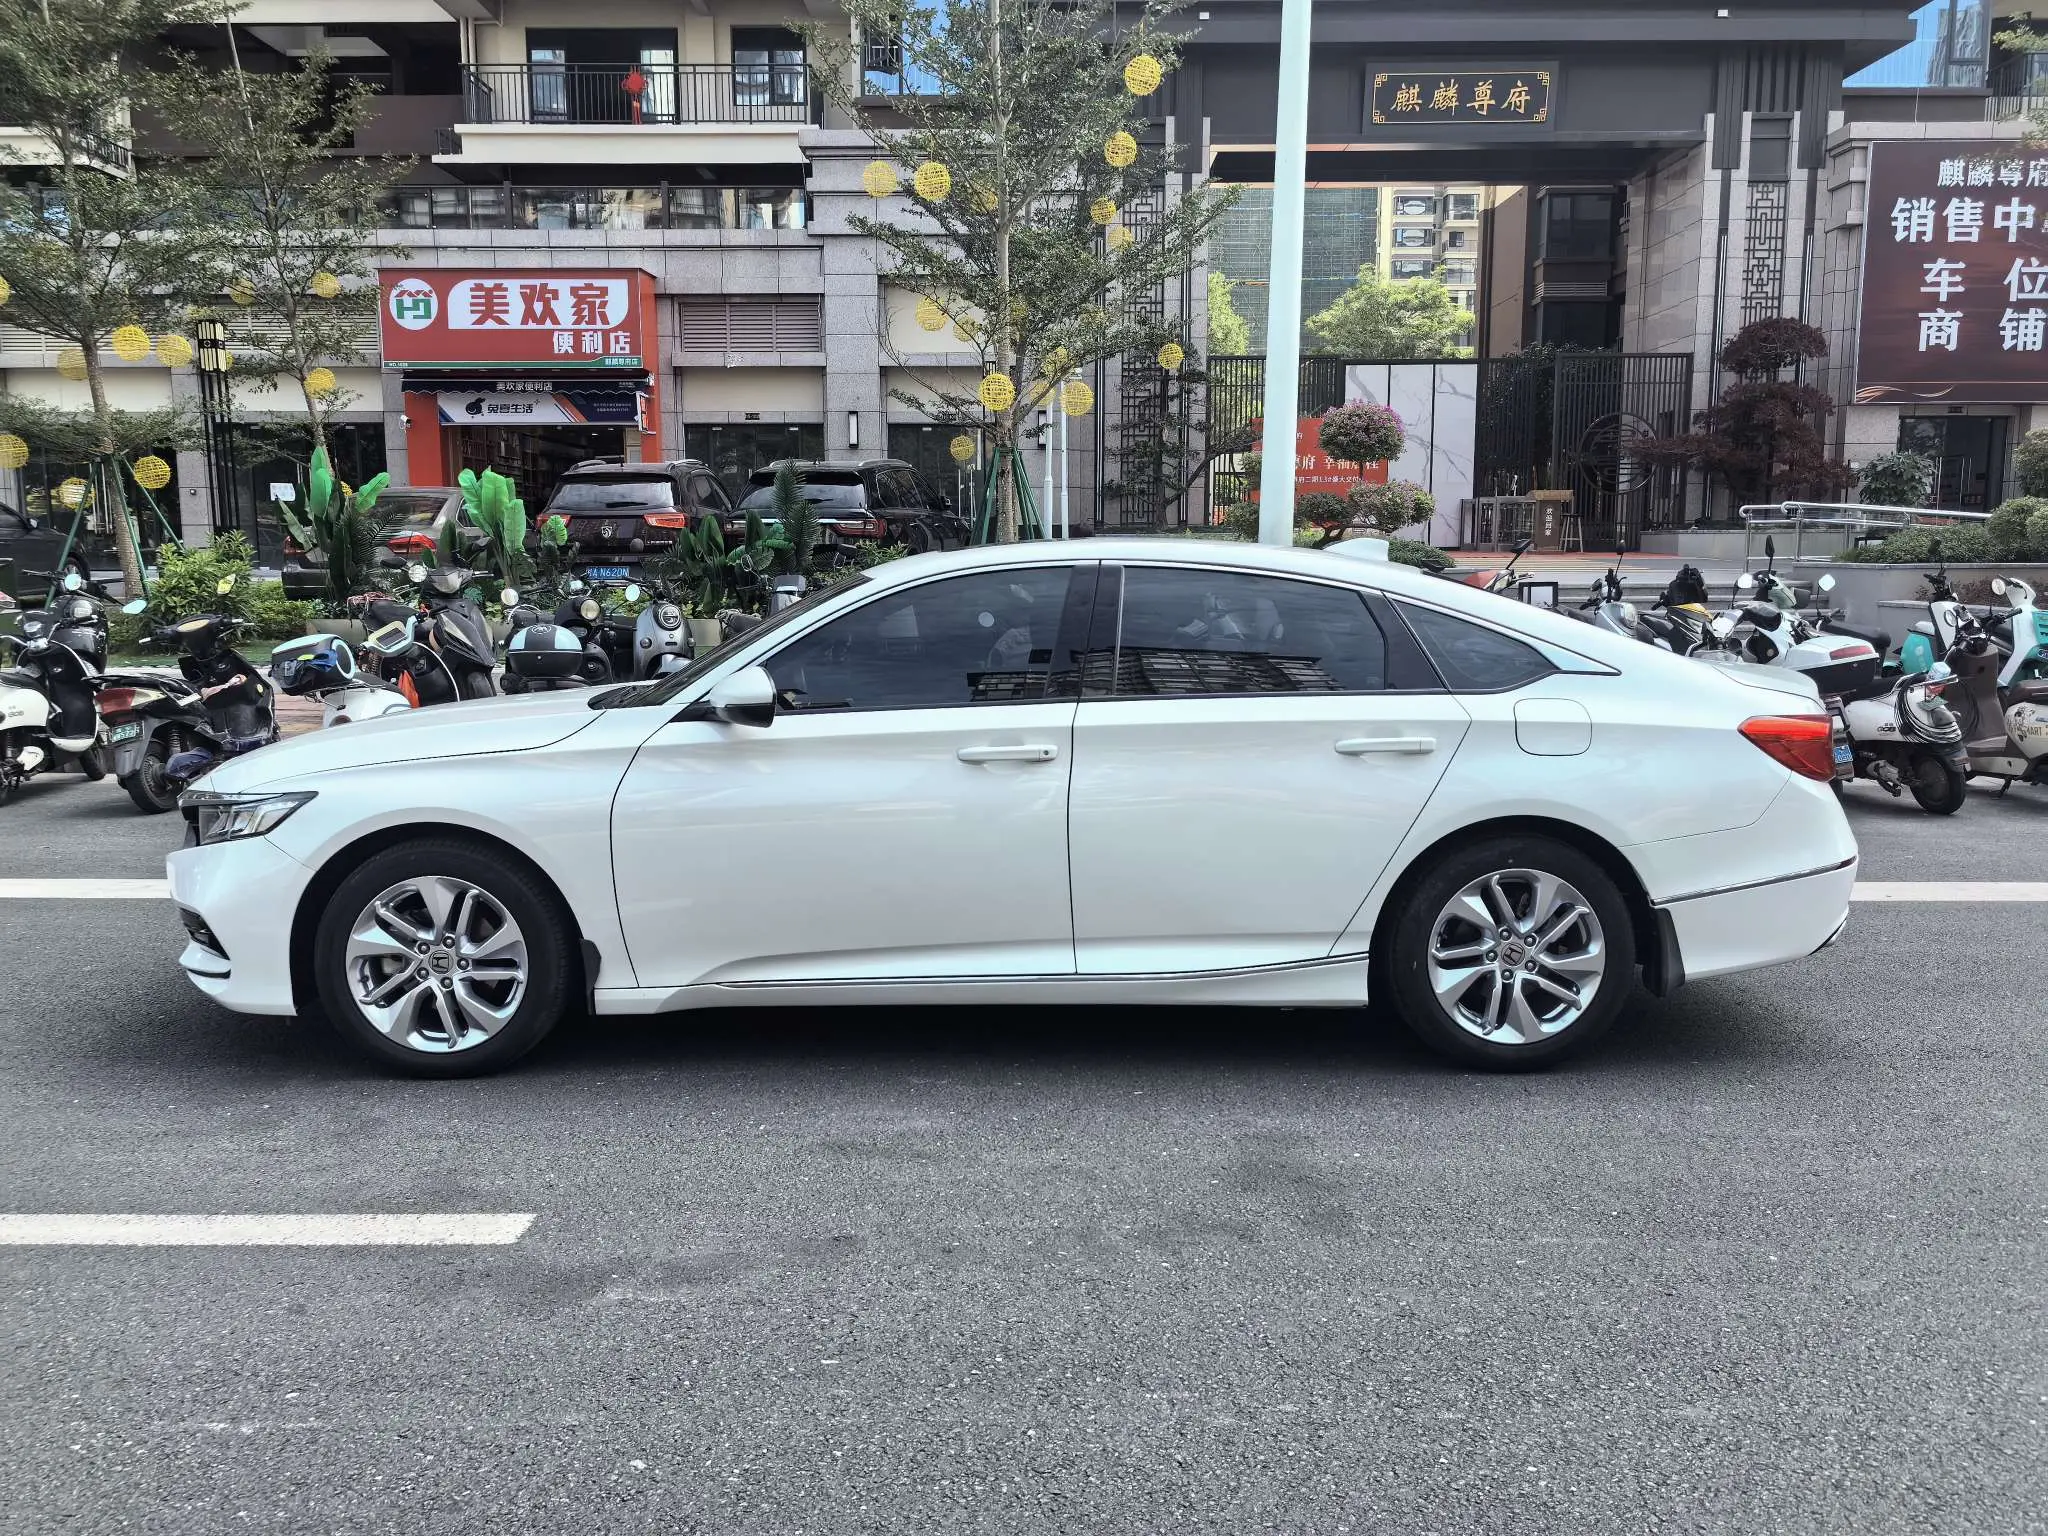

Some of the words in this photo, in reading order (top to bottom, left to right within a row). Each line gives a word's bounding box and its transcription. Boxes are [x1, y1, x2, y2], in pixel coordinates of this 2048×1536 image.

[1390, 79, 1531, 116] 麒麟尊府
[1890, 197, 2036, 243] 销售中
[469, 283, 610, 326] 美欢家
[552, 331, 631, 354] 便利店
[1918, 307, 2047, 352] 商铺
[496, 381, 553, 391] 美欢家便利店
